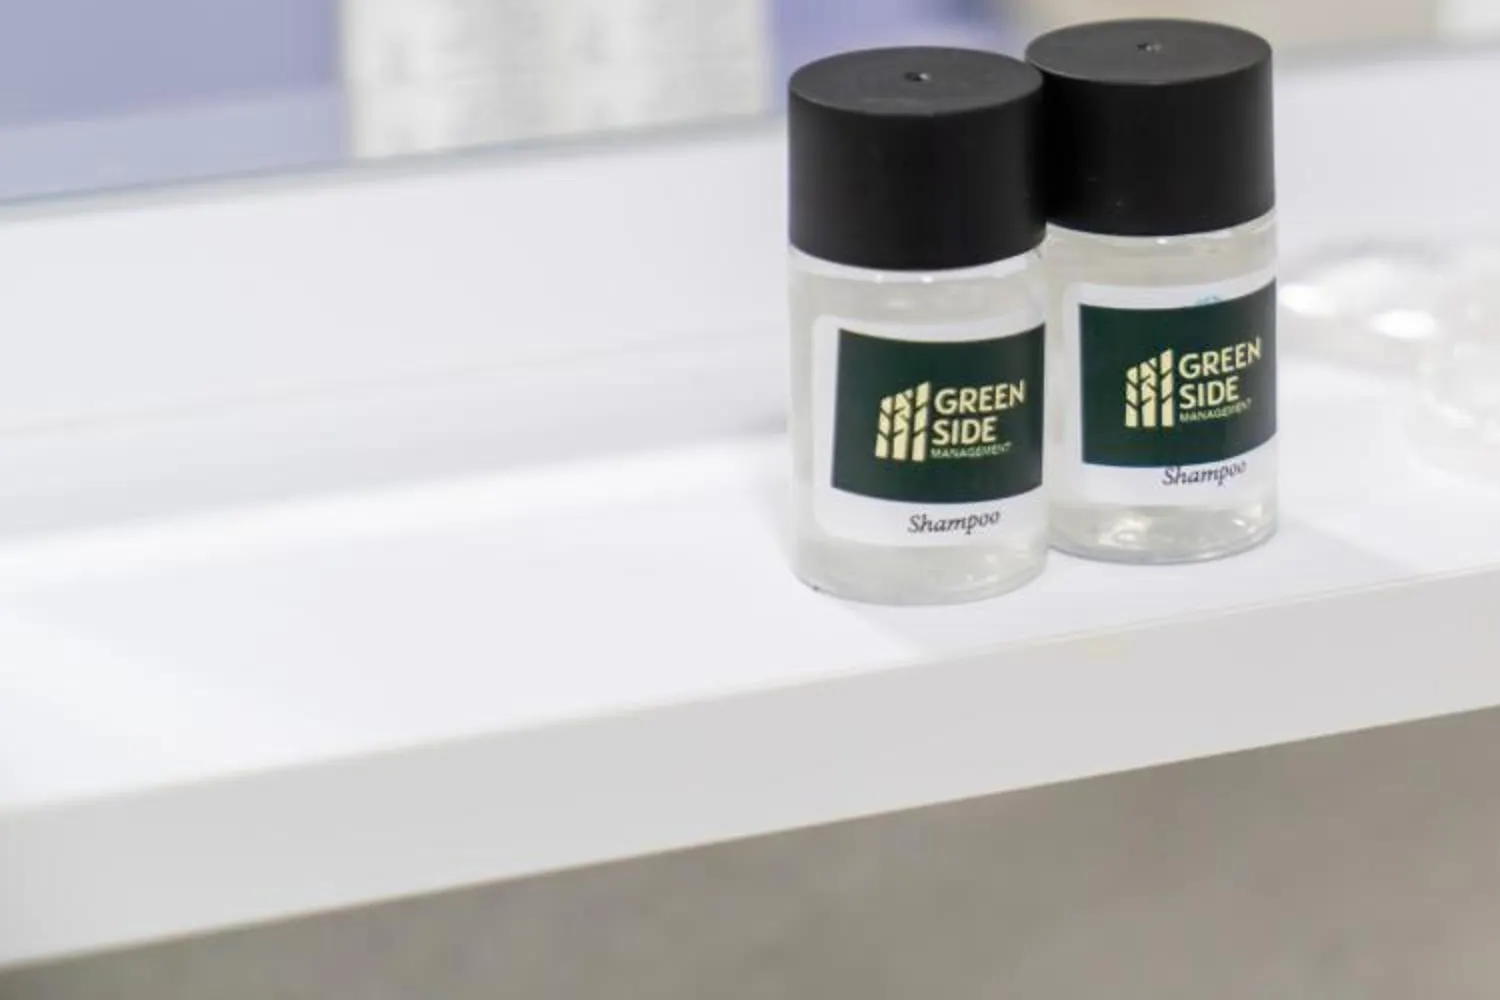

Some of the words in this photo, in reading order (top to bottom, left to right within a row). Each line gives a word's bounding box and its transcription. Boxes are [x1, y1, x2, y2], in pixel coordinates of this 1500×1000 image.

[1179, 336, 1262, 377] GREEN
[935, 379, 1026, 415] GREEN
[1180, 377, 1239, 410] SIDE
[1180, 397, 1251, 422] MANAGEMENT
[931, 416, 998, 446] SIDE
[931, 442, 1012, 460] MANAGEMENT
[1162, 460, 1247, 488] Shampoo
[908, 510, 1000, 535] Shampoo
